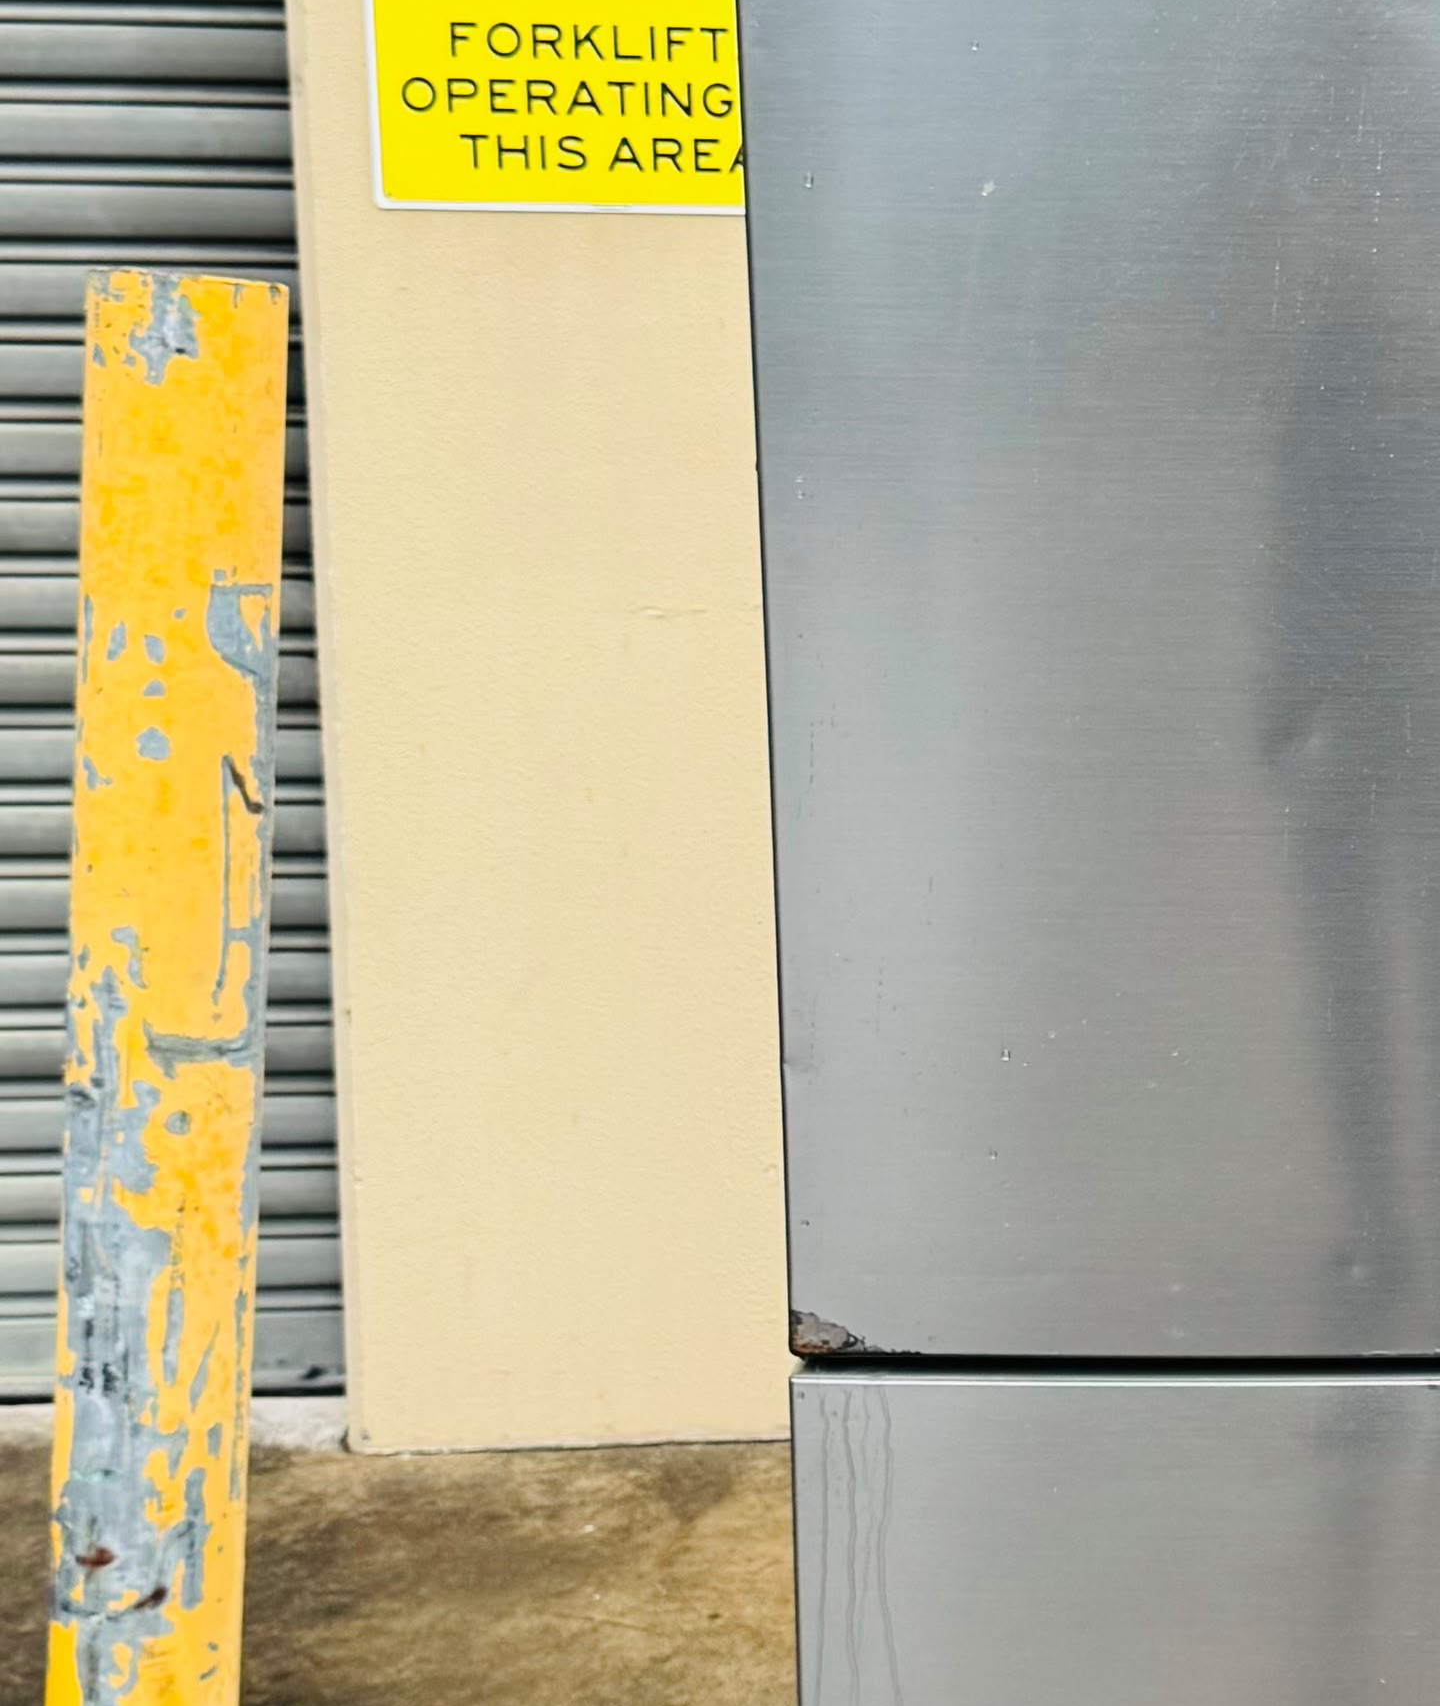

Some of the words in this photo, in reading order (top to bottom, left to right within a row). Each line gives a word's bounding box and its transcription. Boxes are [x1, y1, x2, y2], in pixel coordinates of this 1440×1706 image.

[449, 21, 729, 62] FORKLIFT
[401, 76, 734, 118] OPERATING
[458, 133, 587, 171] THIS
